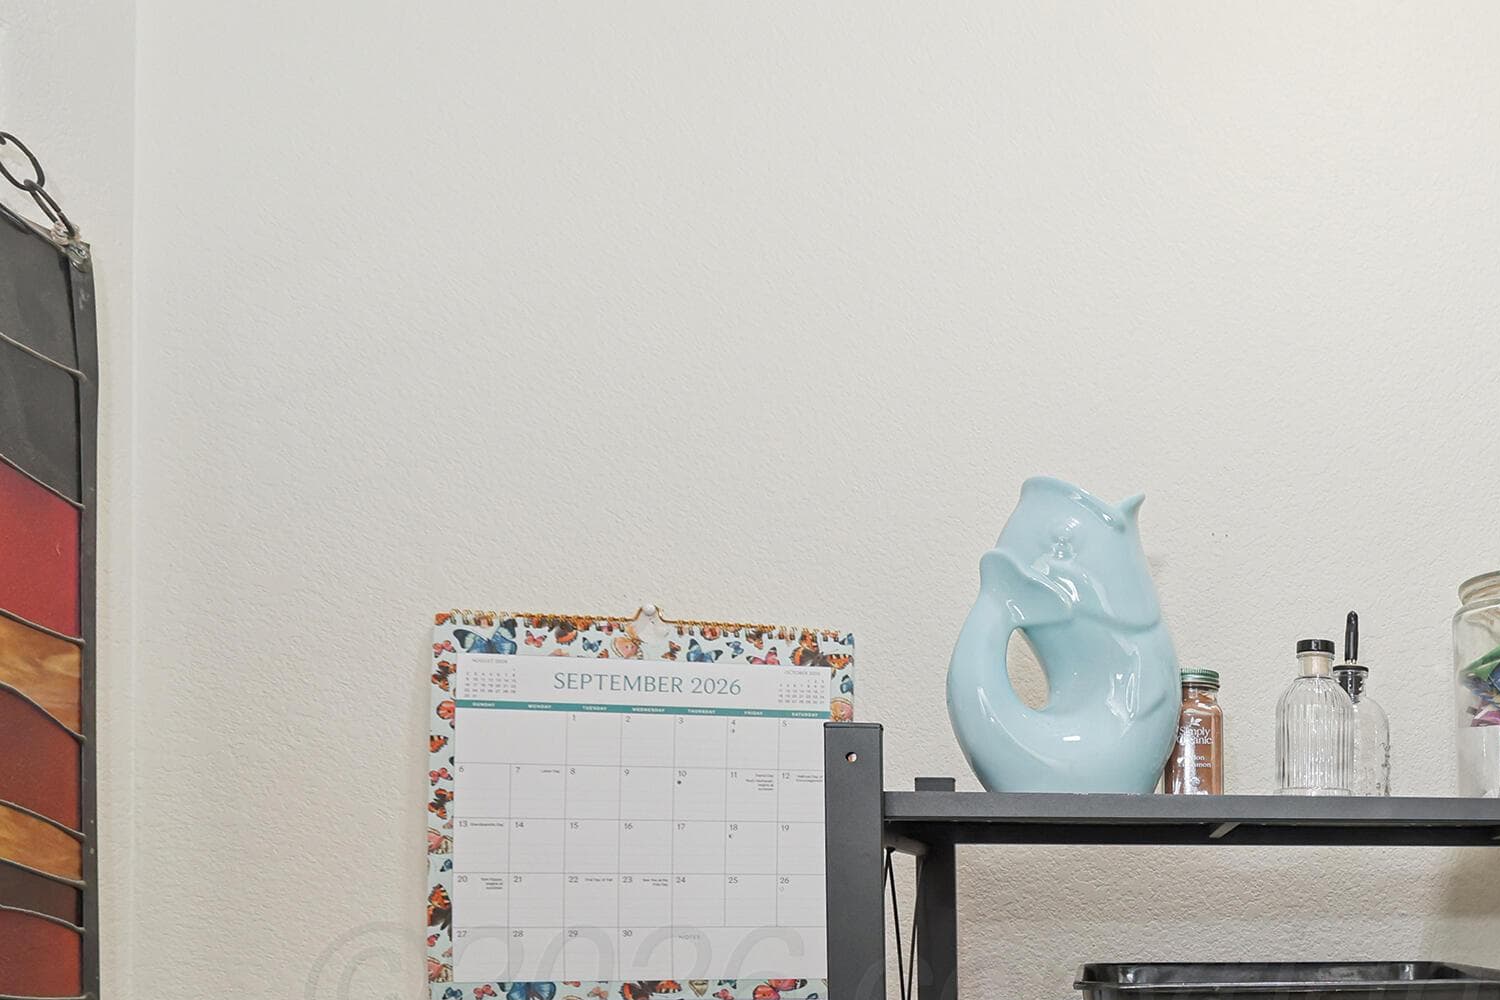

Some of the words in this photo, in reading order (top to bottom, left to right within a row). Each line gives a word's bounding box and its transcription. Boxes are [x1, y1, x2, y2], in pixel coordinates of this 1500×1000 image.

[554, 671, 683, 694] SEPTEMBER
[691, 677, 742, 695] 2026
[459, 820, 468, 828] 13
